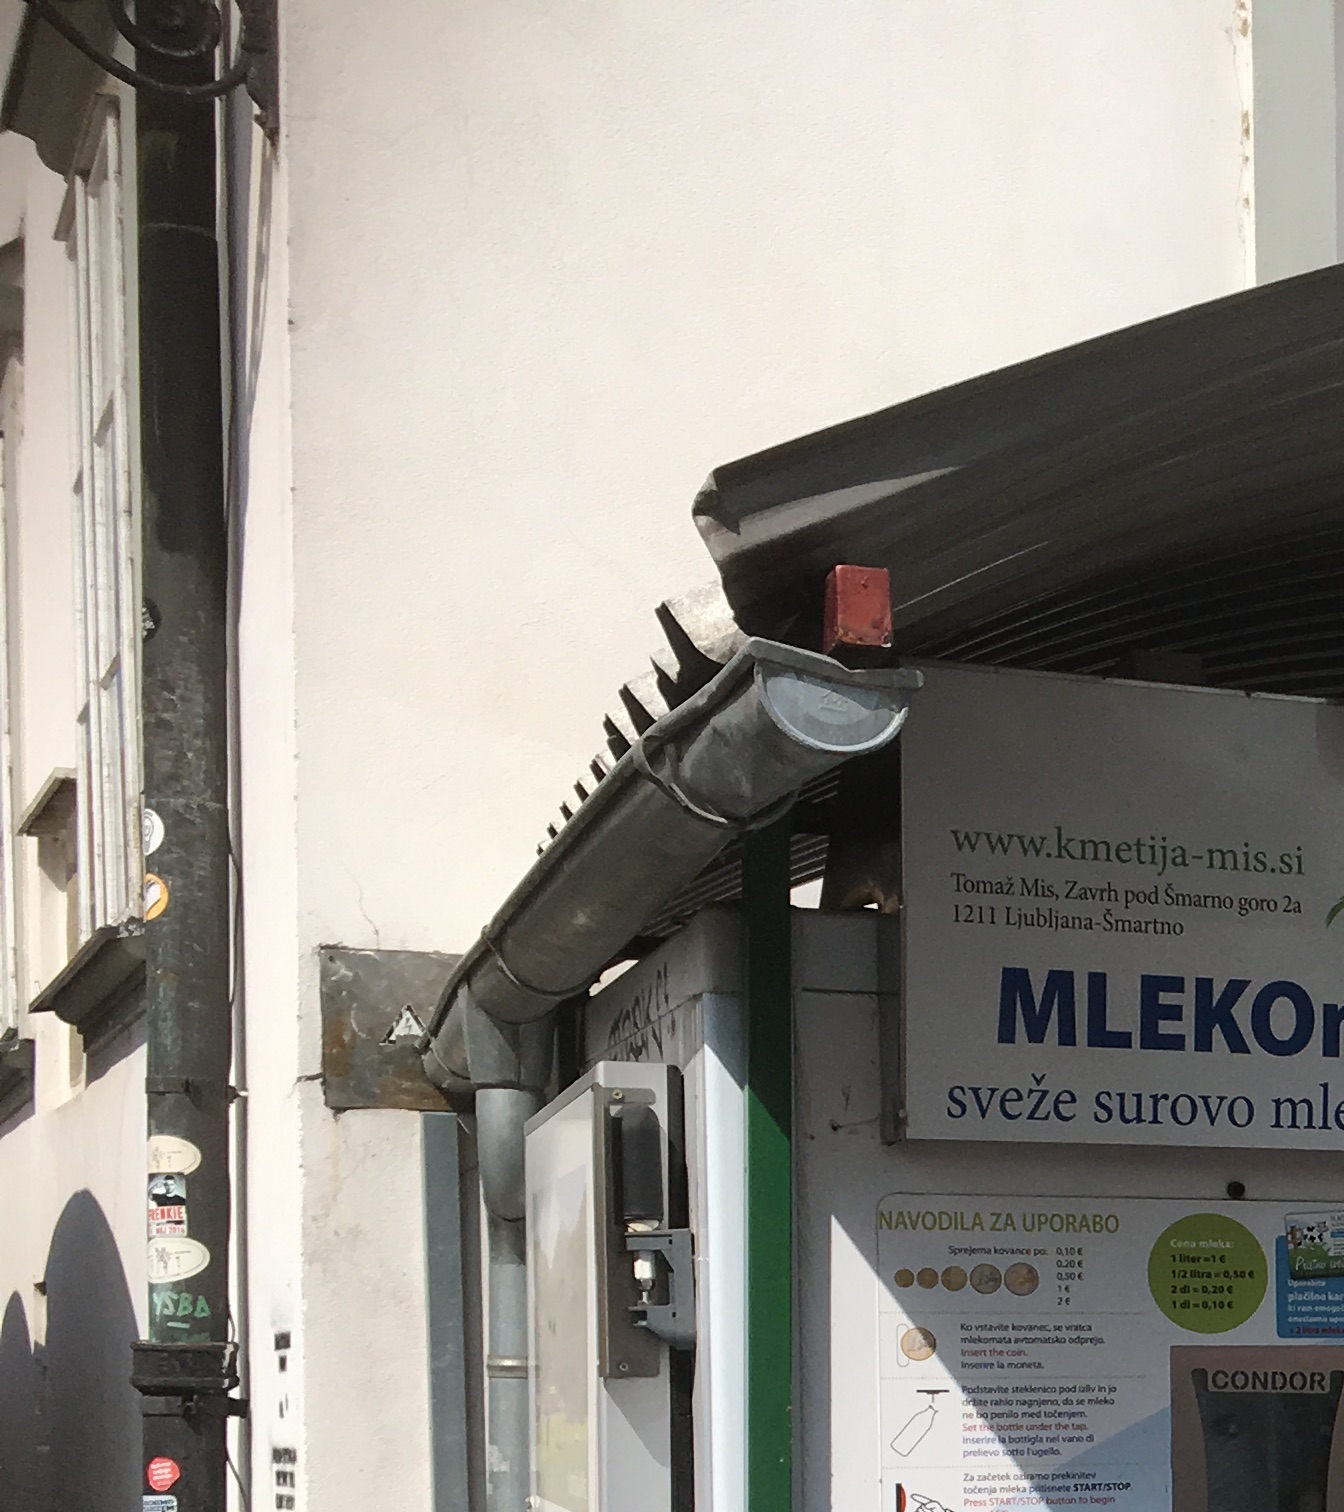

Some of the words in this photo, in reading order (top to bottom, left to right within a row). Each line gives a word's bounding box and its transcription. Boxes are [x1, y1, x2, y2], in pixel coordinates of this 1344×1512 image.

[950, 825, 1306, 879] www.kmetija-mis.si
[950, 871, 1015, 897] Tomaž
[1019, 874, 1060, 904] Mis,
[1065, 878, 1119, 903] Zavrh
[1124, 882, 1160, 912] pod
[1162, 879, 1234, 911] Šmarno
[1238, 892, 1278, 917] goro
[1283, 893, 1303, 915] 2a
[952, 903, 997, 927] 1211
[1004, 906, 1185, 938] Ljubljana-Šmartno
[946, 1071, 1078, 1125] sveže
[1094, 1089, 1256, 1130] surovo
[878, 1210, 984, 1232] NAVODILA
[989, 1212, 1017, 1232] ZA
[1022, 1212, 1120, 1234] UPORABO
[960, 1348, 987, 1356] Insert
[990, 1348, 1004, 1356] the
[1006, 1348, 1028, 1357] coin.
[1210, 1369, 1326, 1392] CONDOR
